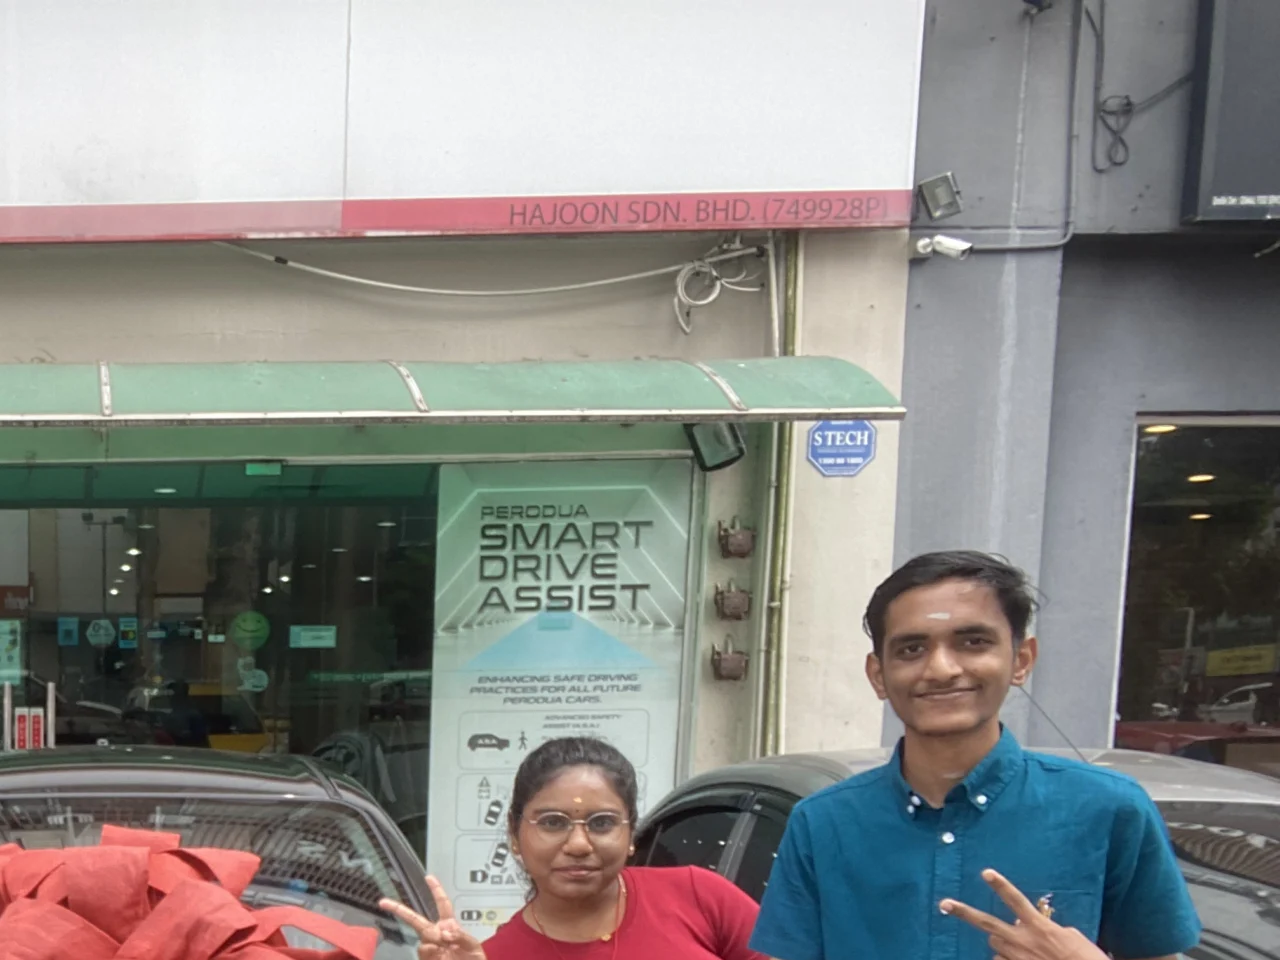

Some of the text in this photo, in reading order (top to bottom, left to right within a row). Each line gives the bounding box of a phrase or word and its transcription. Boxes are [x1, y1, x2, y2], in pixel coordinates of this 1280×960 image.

[509, 196, 889, 226] HAJOON SDN. BHD. (749928P)
[480, 504, 590, 520] PERODUA
[479, 520, 655, 551] SMART
[478, 552, 618, 582] DRIVE
[477, 584, 651, 614] ASSIST
[470, 684, 642, 694] PRACTICES FOR ALL FUTURE
[477, 674, 639, 684] ENHANCING SAFE DRIVING
[503, 696, 563, 705] PERODUA
